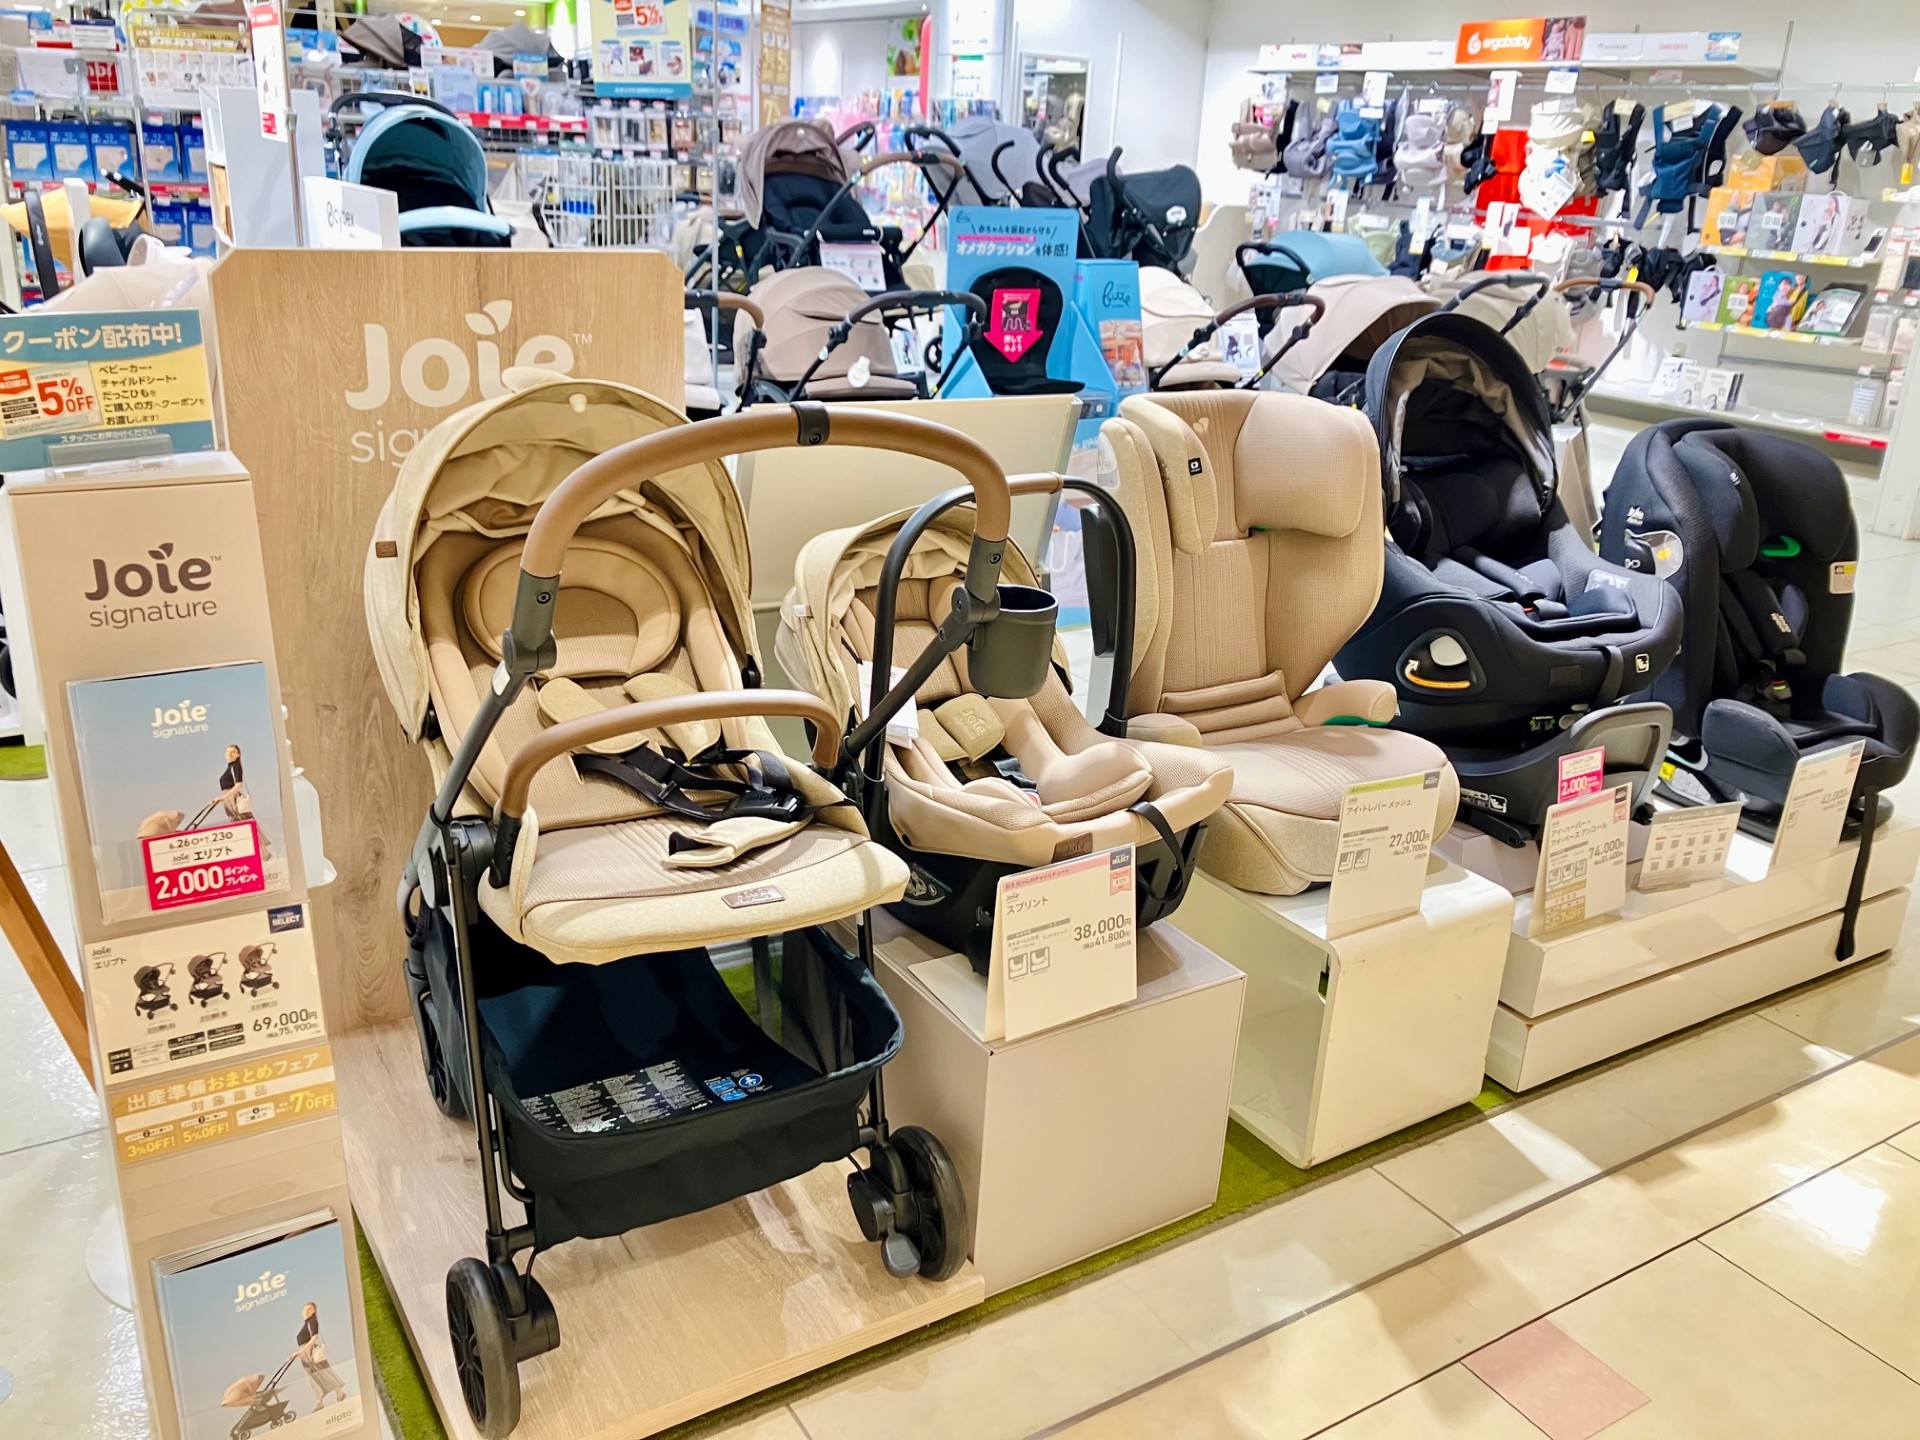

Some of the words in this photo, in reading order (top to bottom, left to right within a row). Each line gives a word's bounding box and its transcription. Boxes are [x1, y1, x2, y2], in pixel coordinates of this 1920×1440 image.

[1482, 35, 1532, 51] ergobaby
[3, 322, 182, 354] クーポン配布中!
[345, 299, 575, 411] Joie
[37, 377, 84, 416] 5%
[66, 396, 94, 413] OFF
[84, 542, 212, 601] Joie
[89, 600, 218, 630] signature
[151, 699, 208, 728] Joie
[961, 706, 986, 734] Joie
[152, 722, 209, 739] signature
[172, 852, 191, 864] Joie
[154, 865, 224, 900] 2,000
[1006, 896, 1049, 915] スプリント
[272, 914, 301, 927] SELECT
[1074, 914, 1132, 942] 38,000円
[253, 1008, 318, 1032] 69,000円
[127, 1053, 320, 1113] 出産準備おまとめフェア
[183, 1123, 230, 1144] 5%OFF!
[127, 1137, 176, 1159] 3%OFF!
[234, 1270, 287, 1303] Joie
[235, 1288, 288, 1314] signature
[326, 1410, 353, 1426] elipto
